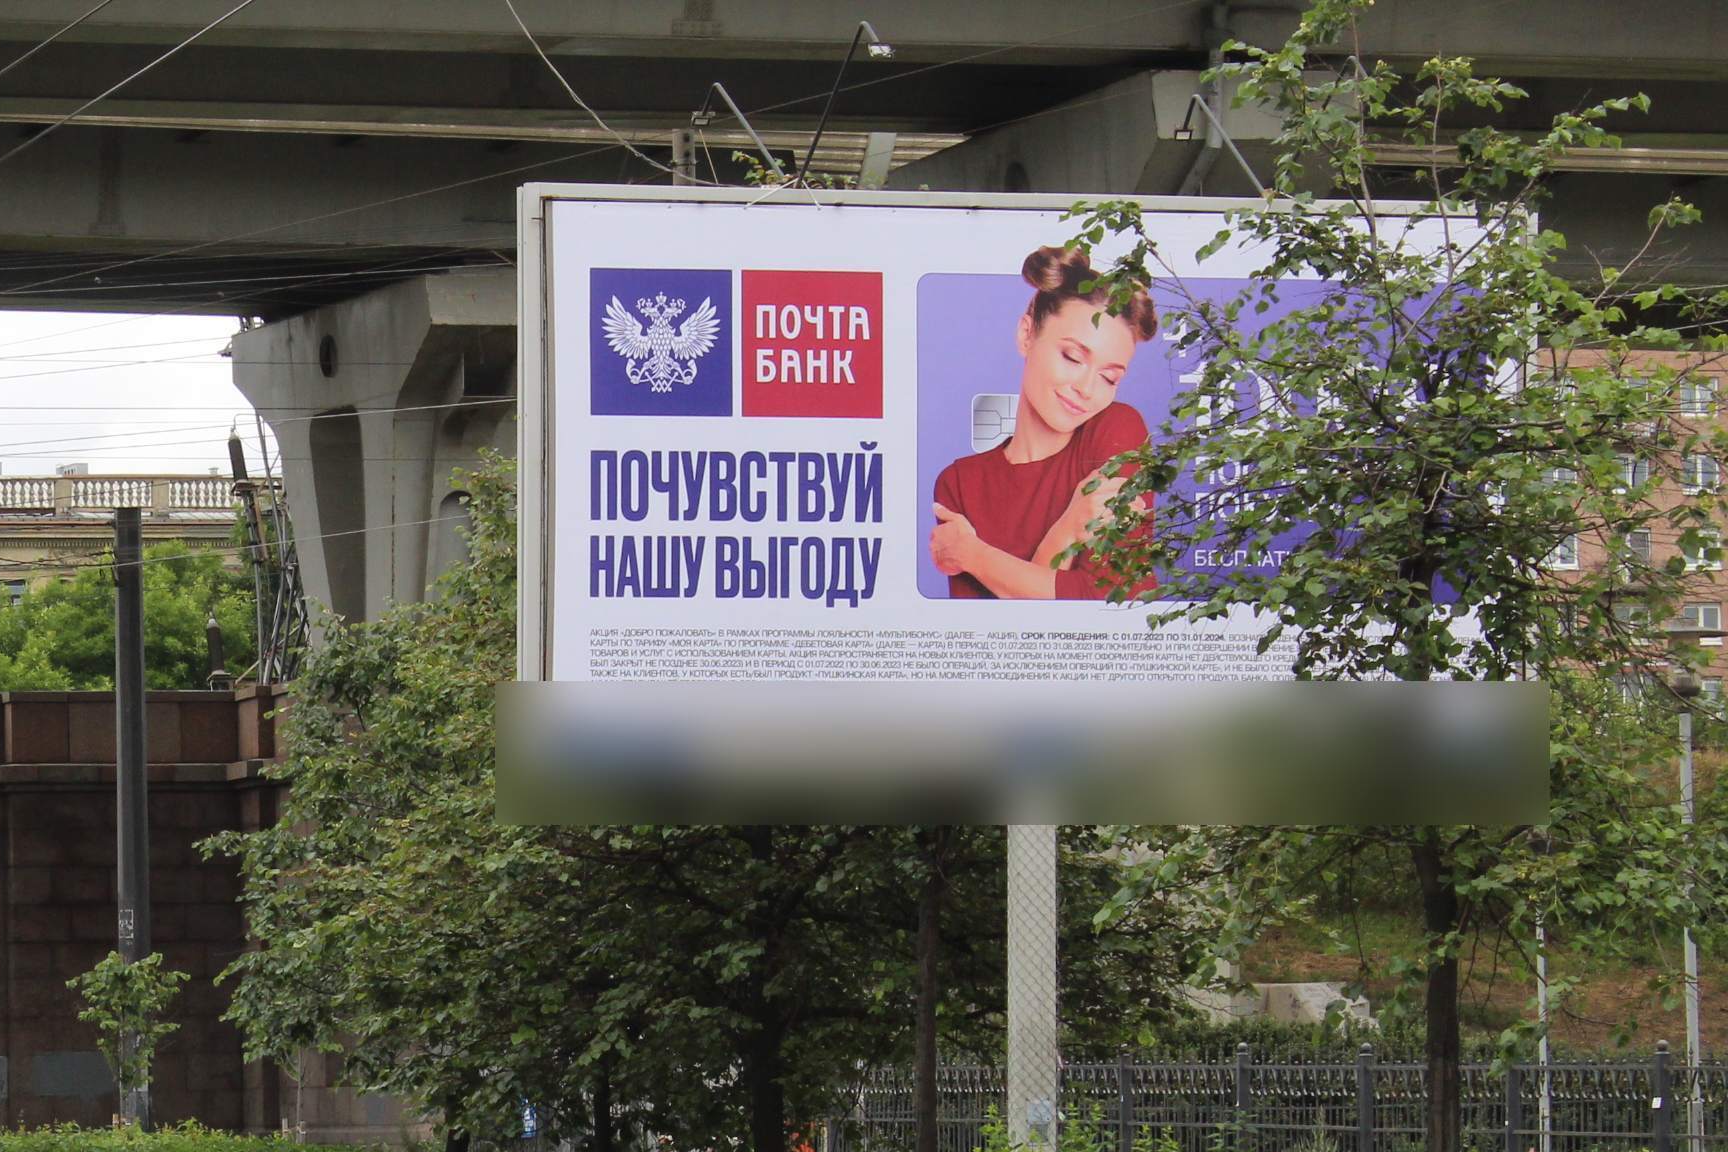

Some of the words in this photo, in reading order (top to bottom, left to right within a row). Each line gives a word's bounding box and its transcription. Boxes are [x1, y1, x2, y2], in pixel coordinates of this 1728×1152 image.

[755, 304, 870, 340] ПОЧТА
[756, 349, 856, 384] БАНК
[590, 441, 883, 523] ПОЧУВСТВУЙ
[590, 535, 705, 598] НАШУ
[715, 536, 882, 608] ВЫГОДУ
